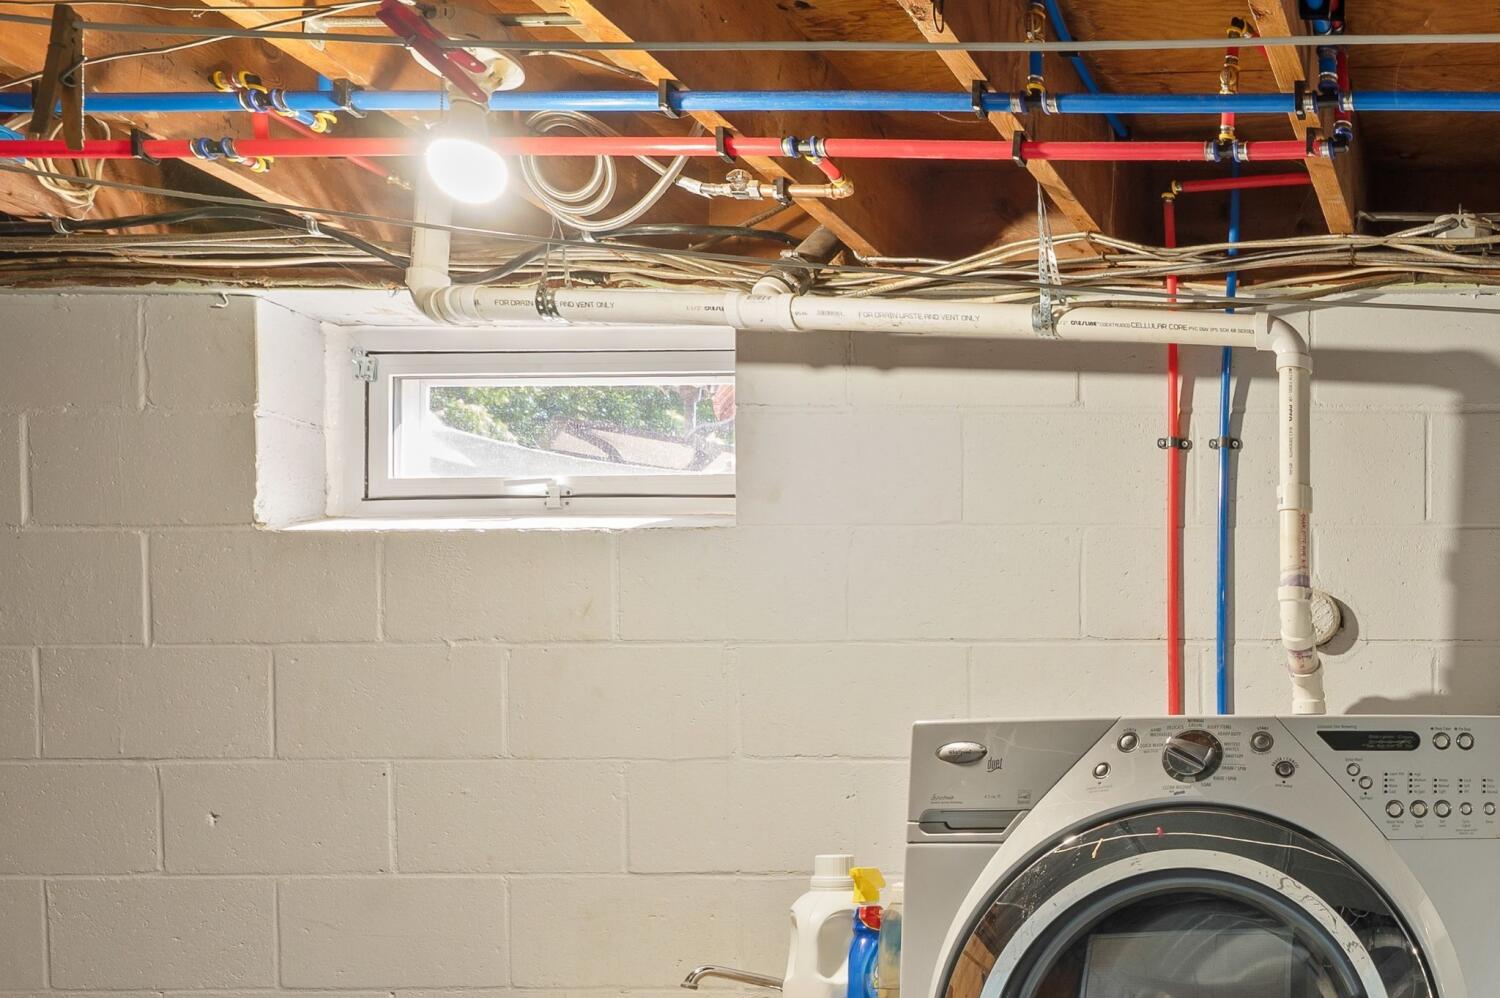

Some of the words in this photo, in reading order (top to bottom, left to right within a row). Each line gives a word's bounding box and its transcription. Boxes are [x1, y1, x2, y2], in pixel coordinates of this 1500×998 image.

[510, 299, 534, 307] DRAIN
[576, 301, 594, 309] VENT
[596, 301, 615, 309] ONLY
[942, 313, 959, 321] VENT
[961, 314, 980, 322] ONLY
[1130, 321, 1168, 330] CELLULAR
[1168, 323, 1188, 331] CORE
